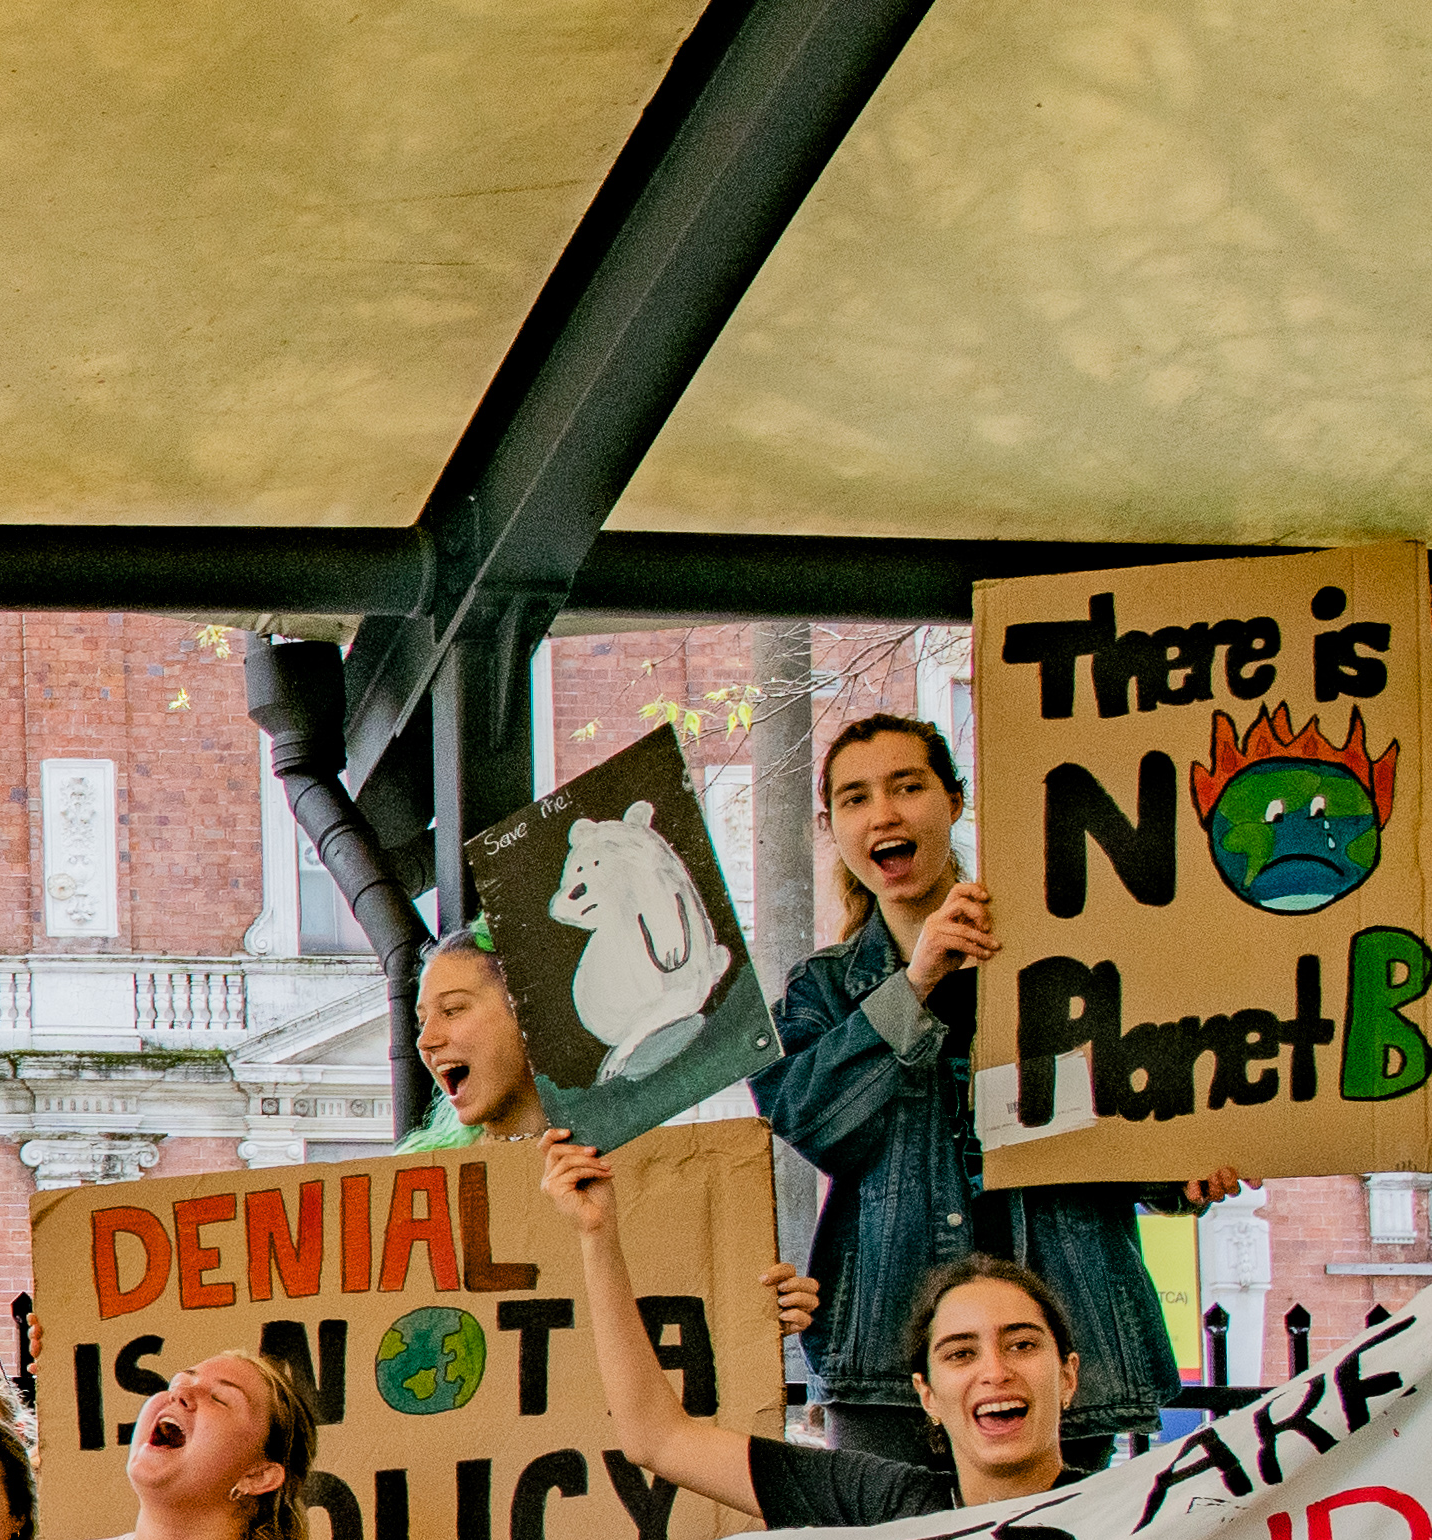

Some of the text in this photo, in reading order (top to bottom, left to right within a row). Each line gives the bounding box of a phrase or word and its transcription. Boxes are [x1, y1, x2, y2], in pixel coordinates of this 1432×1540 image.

[1003, 586, 1390, 719] There is
[484, 822, 527, 855] Save
[1017, 925, 1432, 1128] Planet B
[91, 1161, 540, 1320] DENIAL
